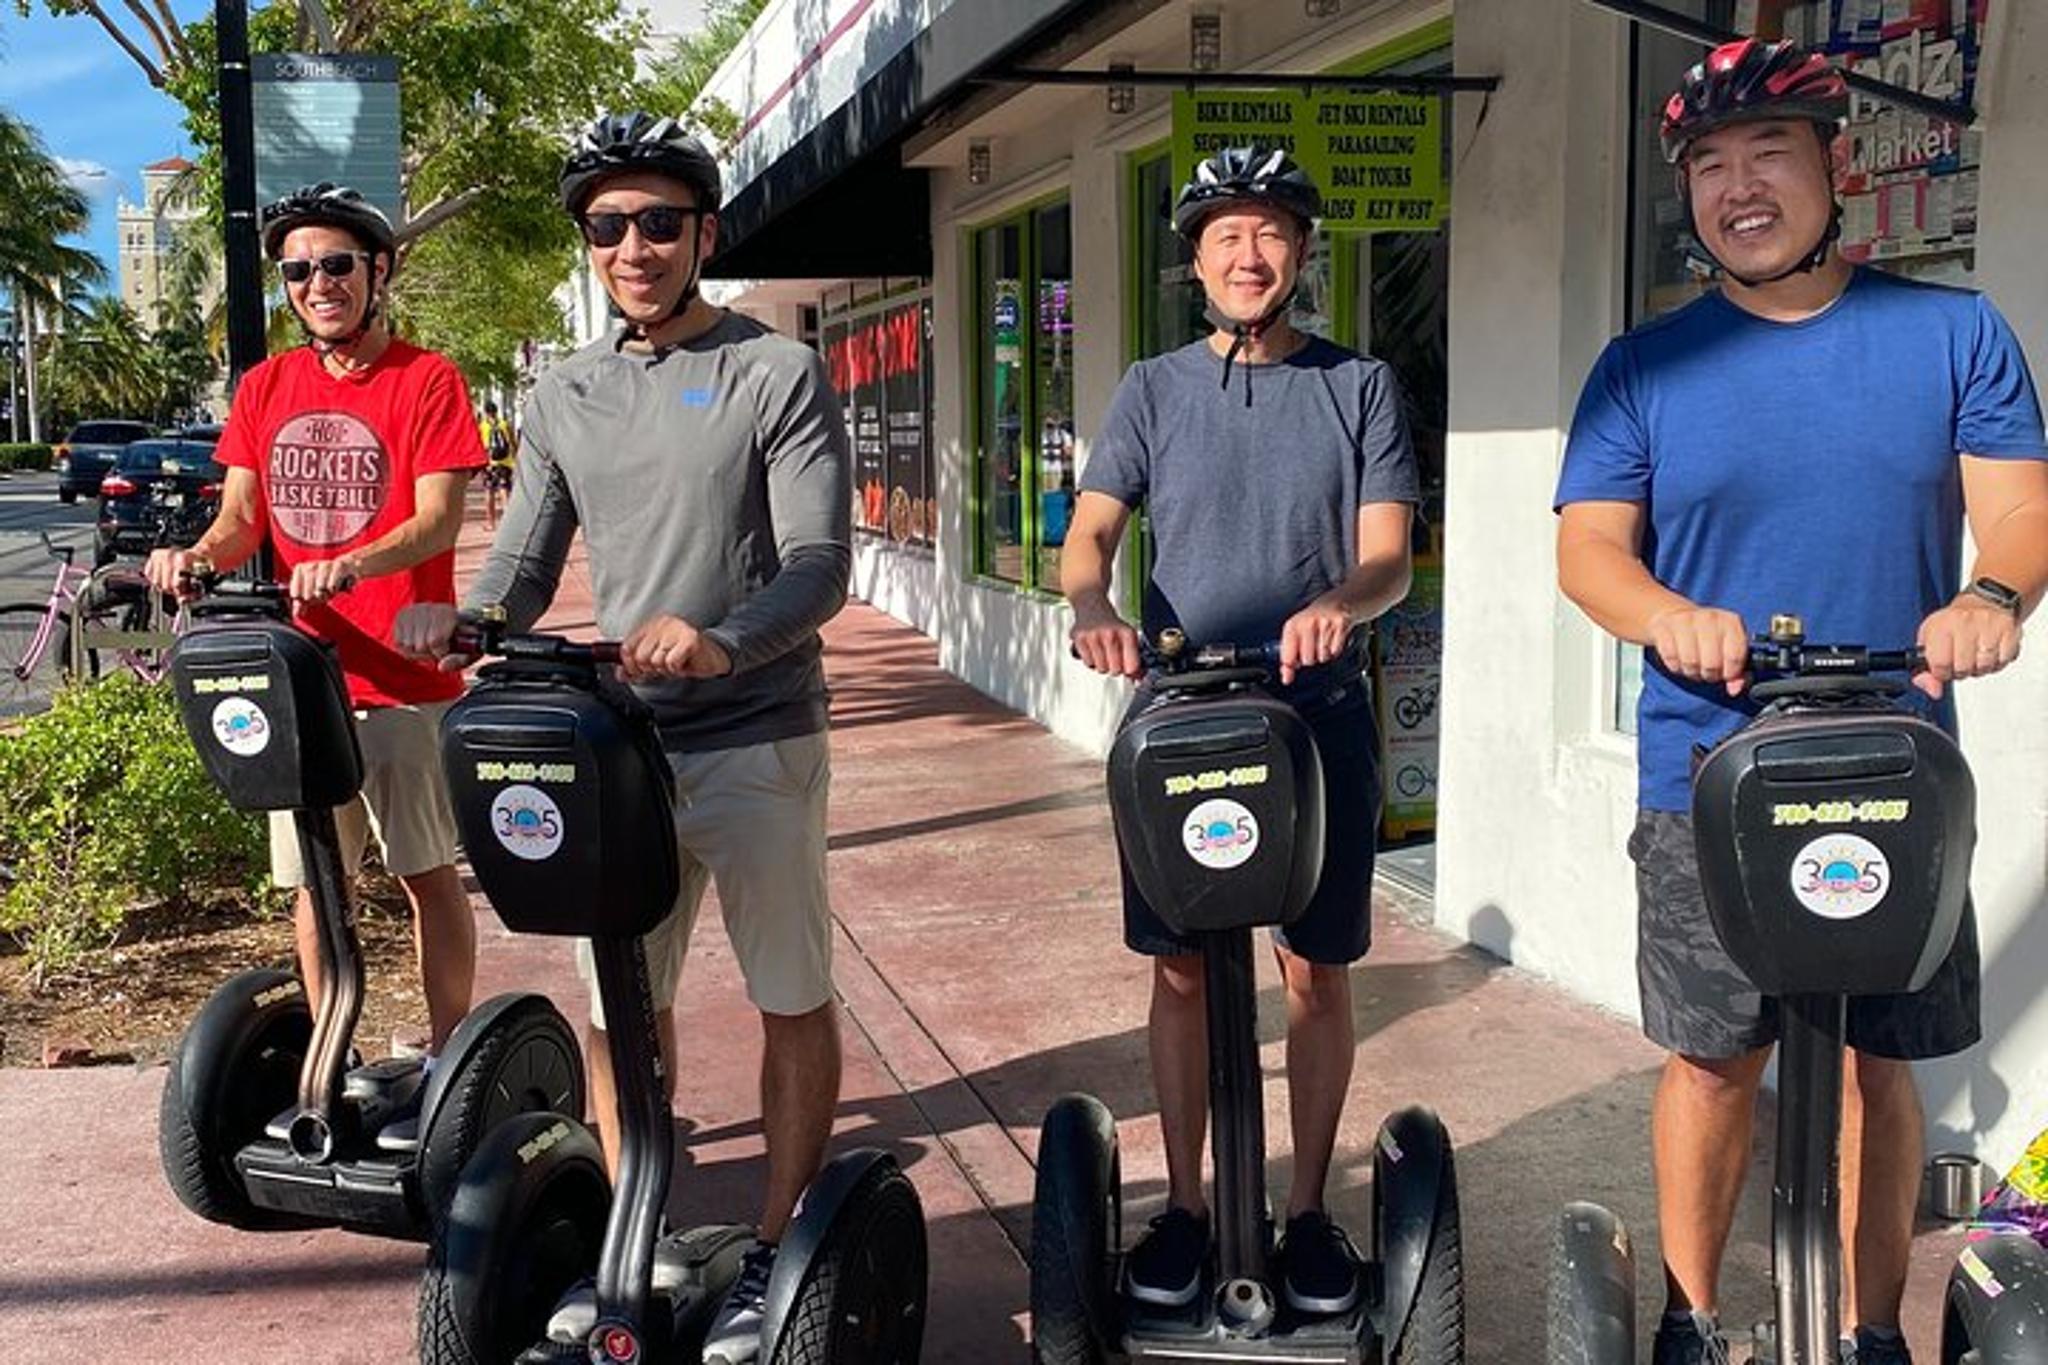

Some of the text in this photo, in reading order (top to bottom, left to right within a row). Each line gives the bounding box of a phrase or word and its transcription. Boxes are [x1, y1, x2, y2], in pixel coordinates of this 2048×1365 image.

[1197, 102, 1292, 123] BIKE RENTALS
[1317, 104, 1426, 126] JET SKI RENTALS
[1328, 136, 1415, 154] PARASAILING
[1852, 121, 1953, 172] Market
[1331, 166, 1411, 187] BOAT TOURS
[1366, 200, 1393, 220] KEY
[1396, 201, 1433, 220] WEST
[271, 446, 379, 481] ROCKETS
